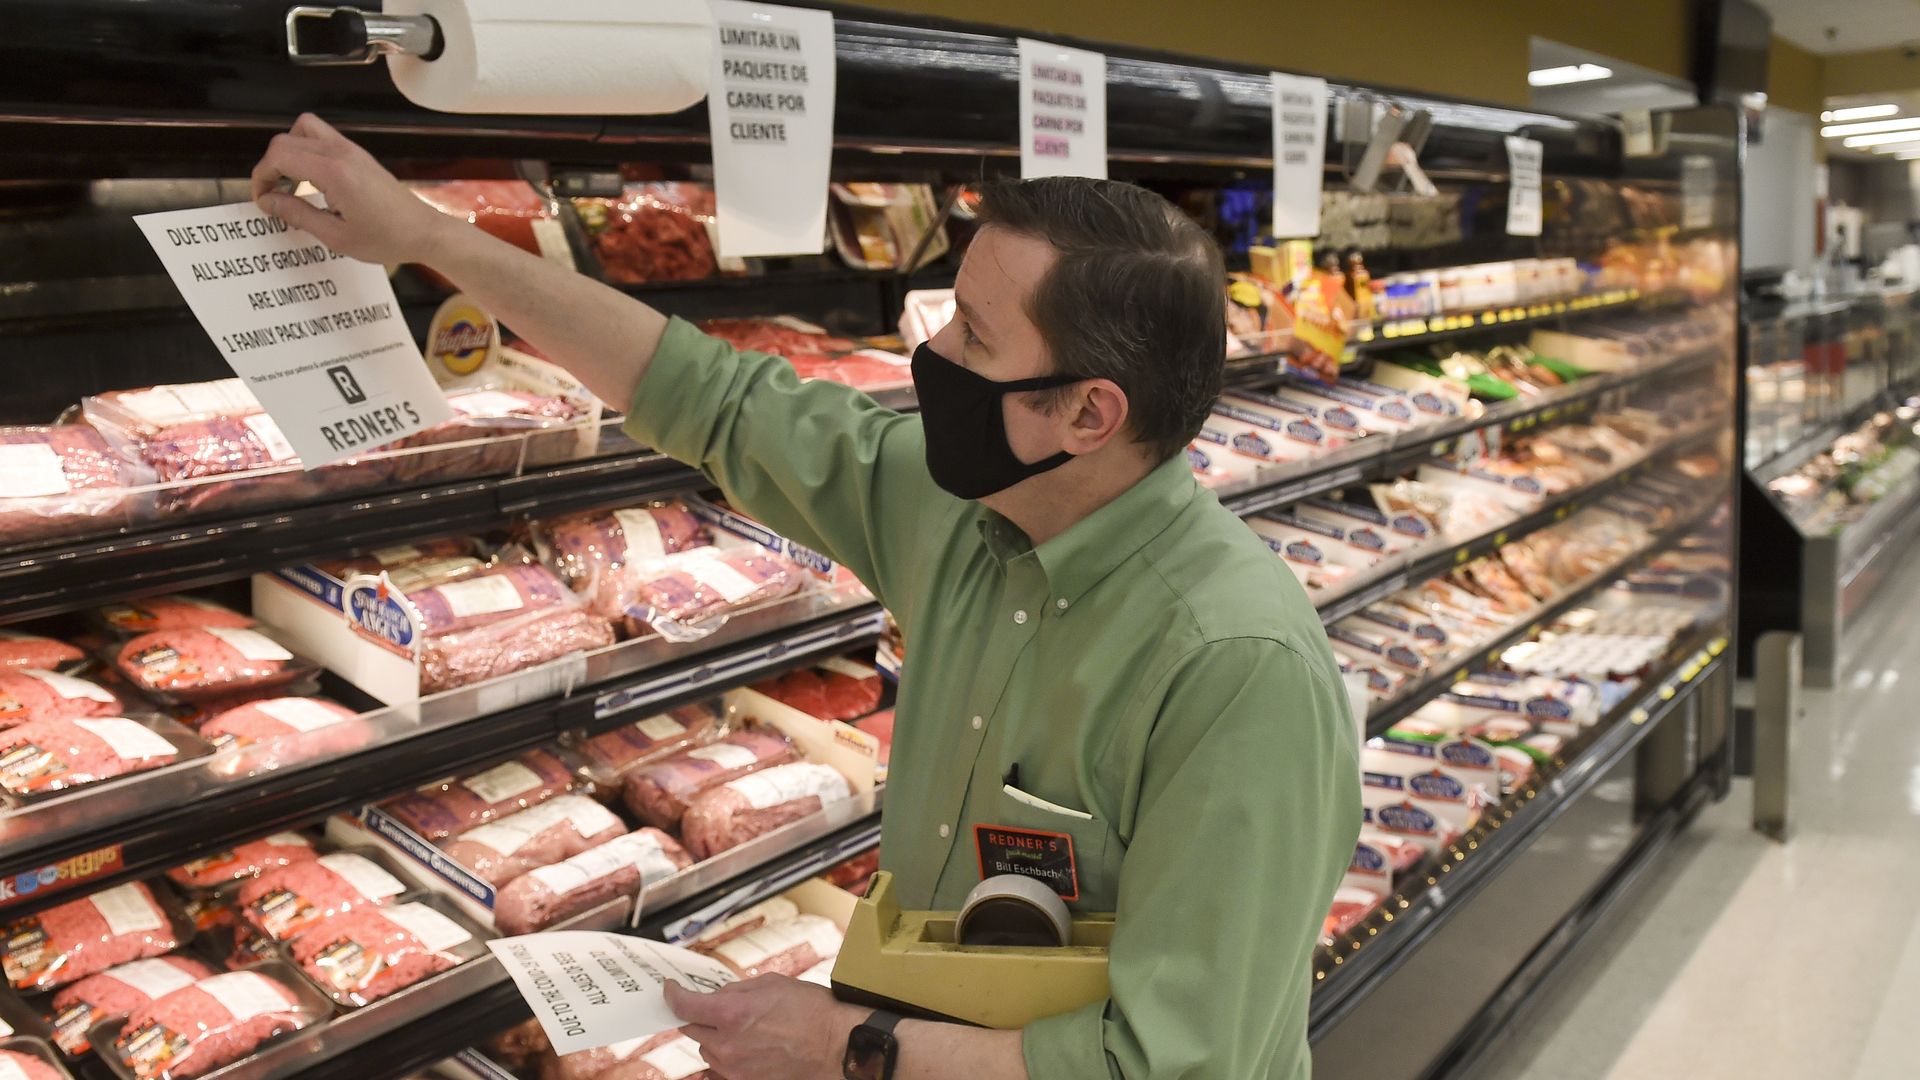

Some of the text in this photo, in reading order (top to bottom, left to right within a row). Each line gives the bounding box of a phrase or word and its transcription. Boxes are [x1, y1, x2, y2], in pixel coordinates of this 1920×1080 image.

[720, 27, 801, 50] LIMITAR UN
[723, 59, 809, 83] PAQUETE DE
[726, 91, 805, 112] CARNE POR
[730, 122, 787, 141] CLIENTE
[166, 216, 290, 246] DUE TO THE COVID
[192, 262, 218, 282] ALL
[215, 257, 254, 278] SALES
[253, 254, 272, 272] OF
[271, 245, 326, 270] GROUND
[248, 279, 338, 311] ARE LIMITED TO
[222, 302, 393, 353] 1 FAMILY PACK UNIT PER FAMILY
[320, 400, 420, 451] REDNER'S
[989, 833, 1057, 852] REDNER'S
[996, 861, 1057, 878] Bill Eschbach
[563, 966, 584, 975] OF
[597, 958, 630, 980] LIMITED
[570, 973, 599, 993] SALES
[617, 979, 644, 992] ARE
[541, 989, 565, 1004] THE
[586, 991, 610, 1005] ALL
[552, 1003, 573, 1016] TO
[559, 1015, 586, 1036] DUE
